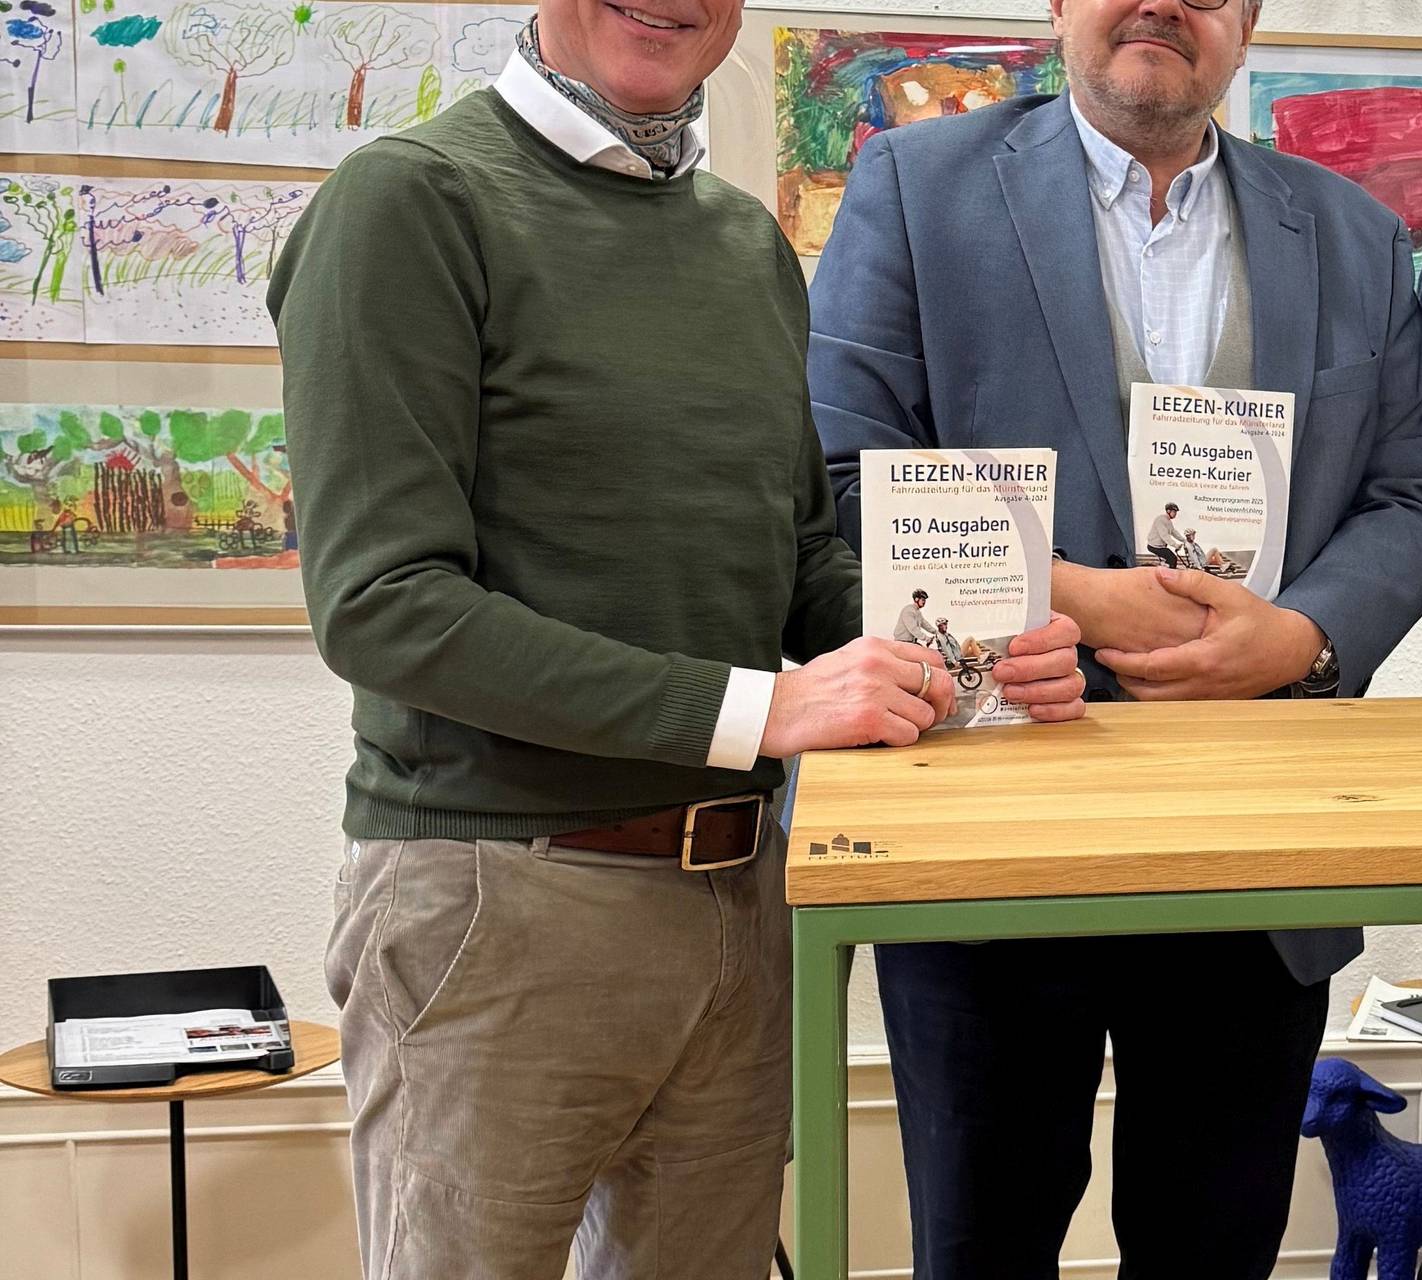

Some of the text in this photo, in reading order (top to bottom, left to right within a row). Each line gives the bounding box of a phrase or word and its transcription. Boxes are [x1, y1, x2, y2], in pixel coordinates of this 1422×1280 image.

[1152, 396, 1285, 419] LEEZEN-KURIER
[1152, 414, 1210, 426] Fahrradzeitung
[1212, 417, 1223, 425] für
[1240, 419, 1285, 429] Münsterland
[1152, 441, 1253, 461] 150 Ausgaben
[891, 464, 1047, 482] LEEZEN-KURIER
[1149, 463, 1252, 482] Leezen-Kurier
[891, 484, 1048, 495] Fahrradzeitung für das Münsterland
[892, 516, 1010, 536] 150 Ausgaben
[892, 541, 1009, 560] Leezen-Kurier
[913, 562, 926, 570] das
[928, 562, 948, 570] Glück
